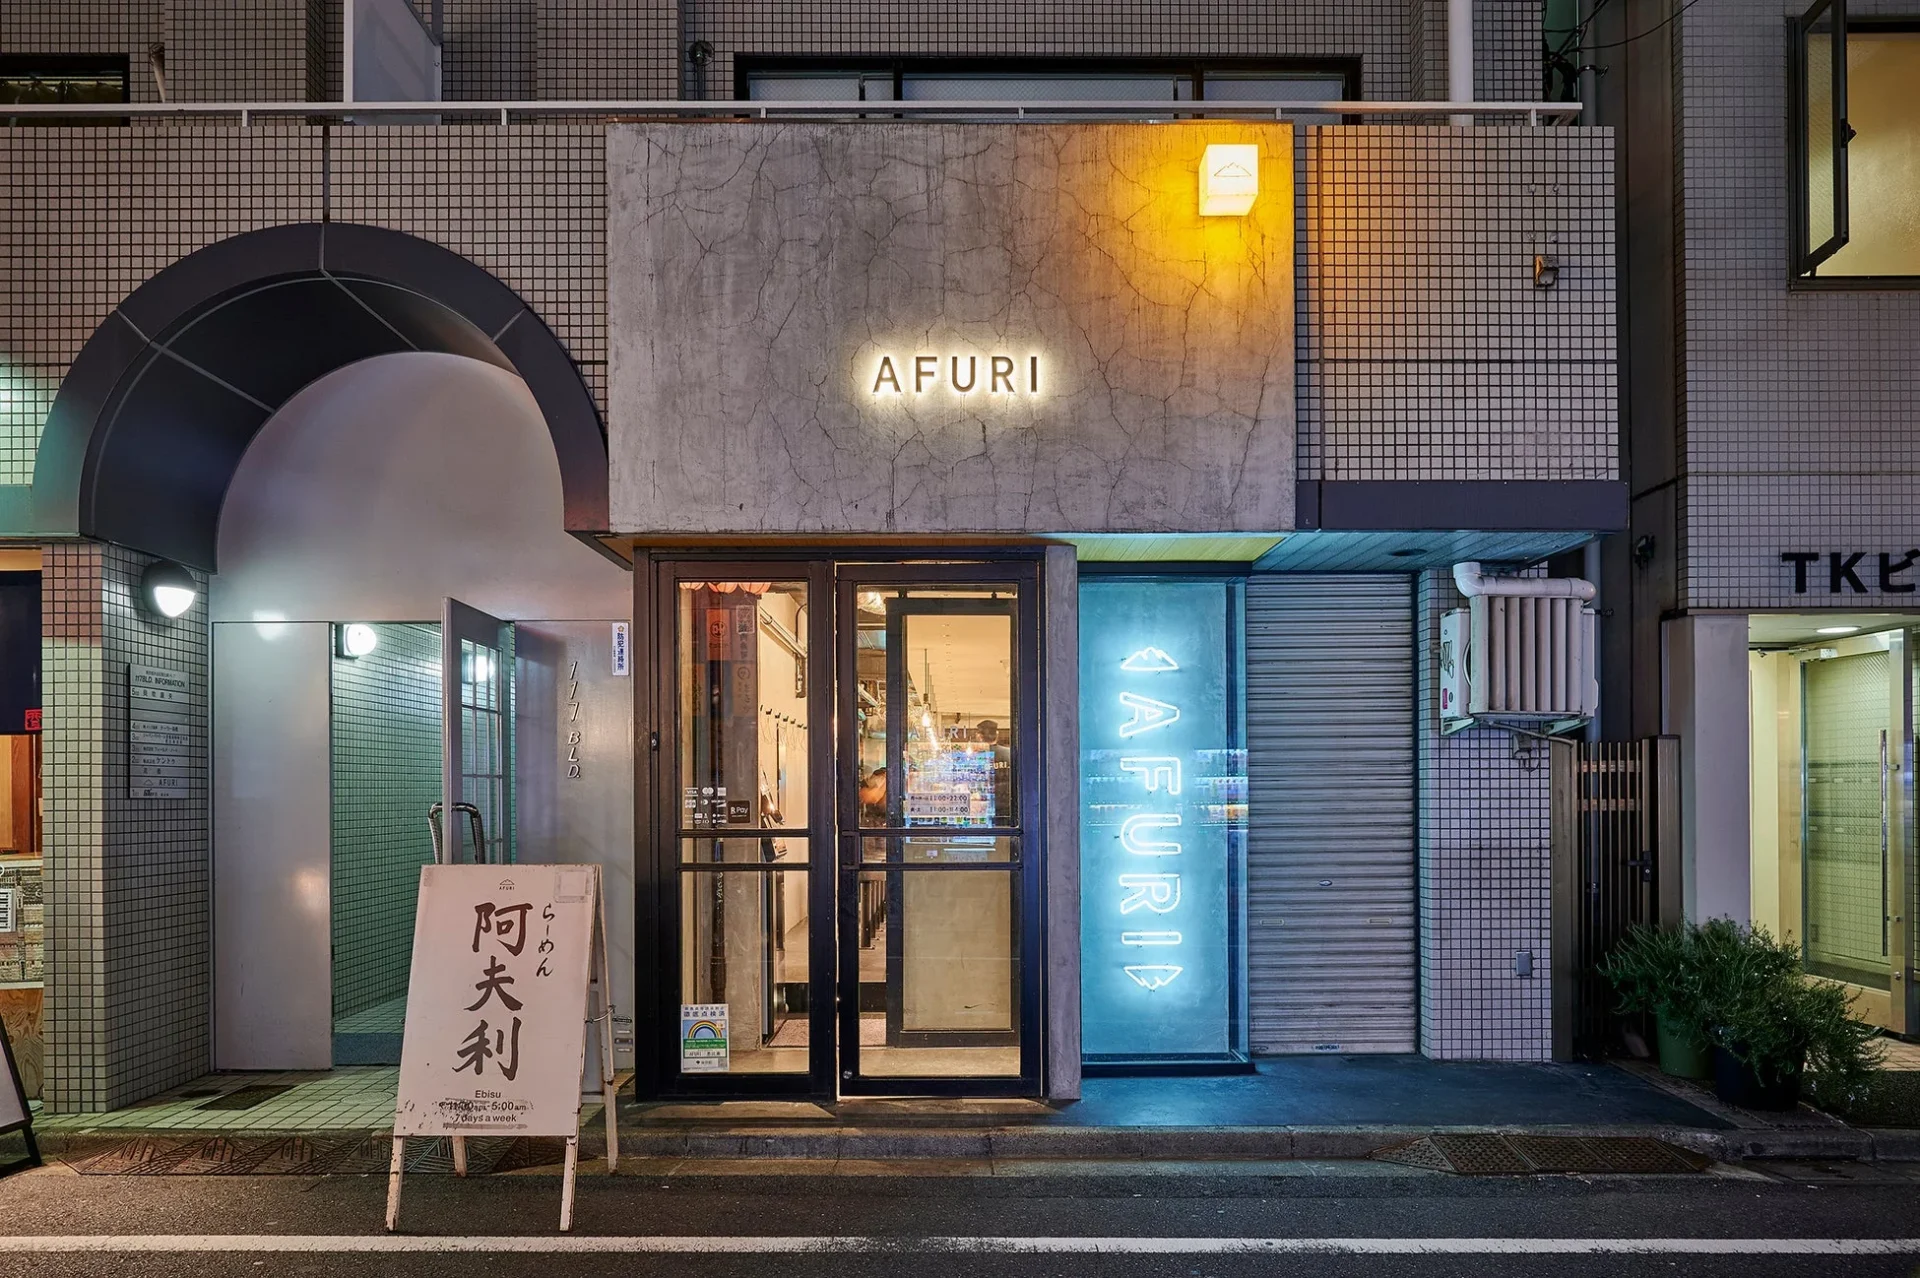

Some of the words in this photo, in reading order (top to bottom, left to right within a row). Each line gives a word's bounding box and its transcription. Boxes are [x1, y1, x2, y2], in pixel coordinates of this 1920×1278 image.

[872, 356, 1038, 393] AFURI
[1781, 548, 1920, 593] TKビ
[155, 677, 186, 688] INFORMATION
[567, 661, 580, 722] 117
[910, 724, 968, 739] AFURI
[1119, 692, 1182, 947] AFURI
[536, 902, 556, 978] らーめん
[452, 901, 534, 1082] 阿夫利
[475, 1090, 502, 1099] Ebisu
[492, 1114, 517, 1122] week
